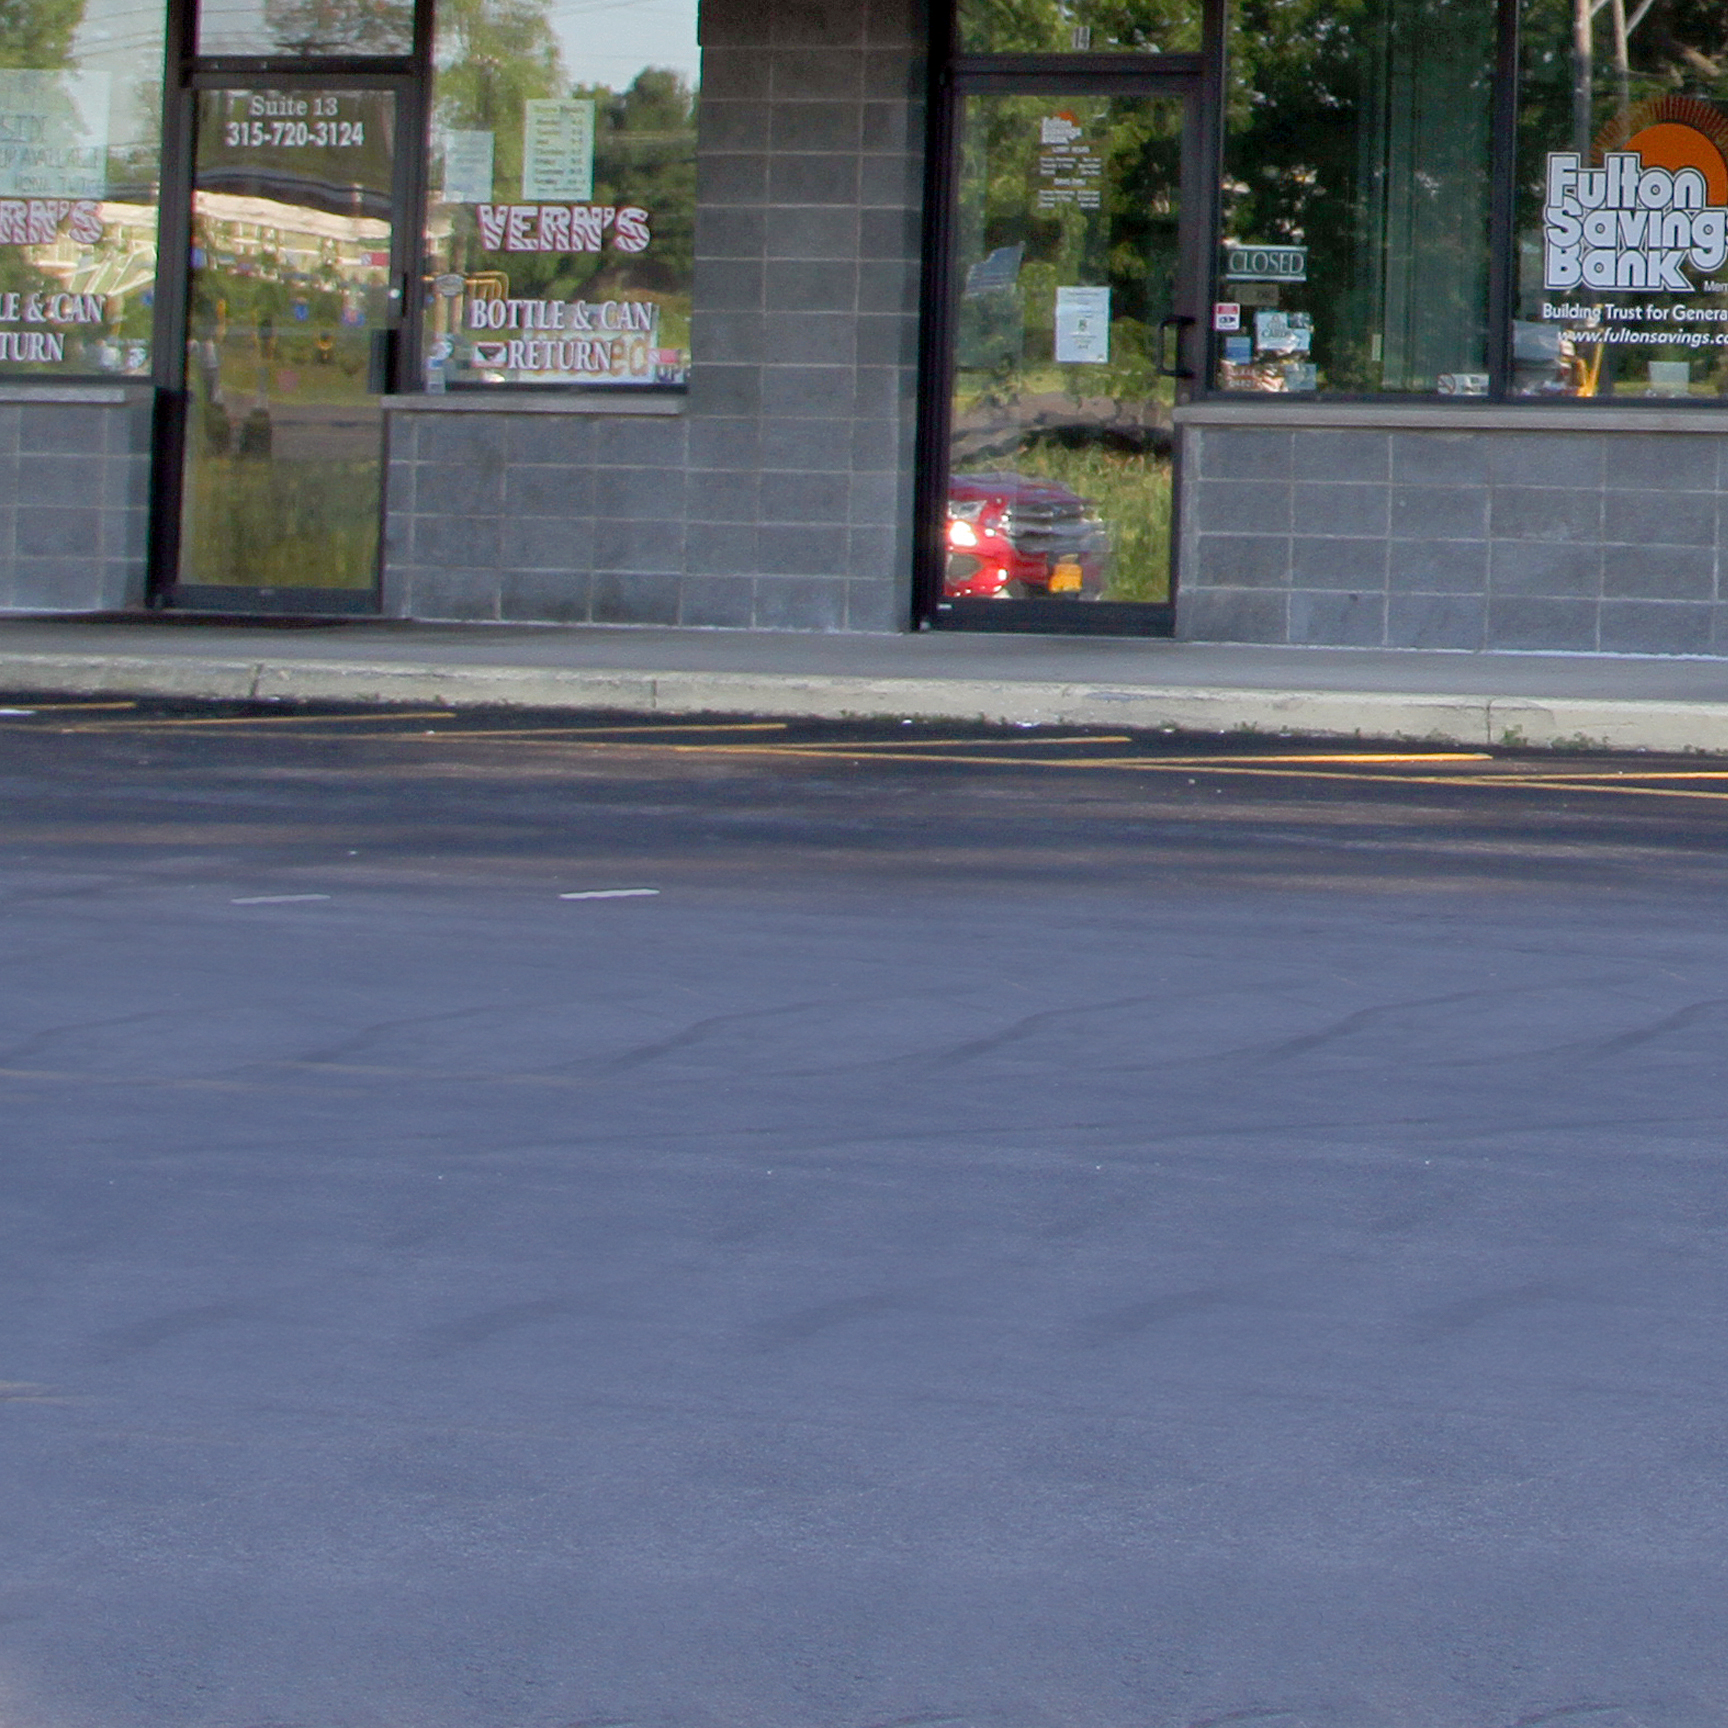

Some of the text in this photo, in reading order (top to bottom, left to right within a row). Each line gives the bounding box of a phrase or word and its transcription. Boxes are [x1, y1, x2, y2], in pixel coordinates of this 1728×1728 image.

[250, 95, 339, 117] Suite 13
[224, 121, 365, 147] 315-720-3124
[1550, 155, 1704, 210] Fulton
[475, 204, 652, 253] VERN'S
[1229, 250, 1305, 274] CLOSED
[1548, 246, 1688, 288] Bank
[53, 292, 107, 323] CAN
[470, 298, 653, 331] BOTTLE & CAN
[1543, 303, 1601, 321] Building
[1605, 304, 1643, 320] Trust
[1646, 303, 1669, 321] for
[508, 339, 614, 371] RETURN
